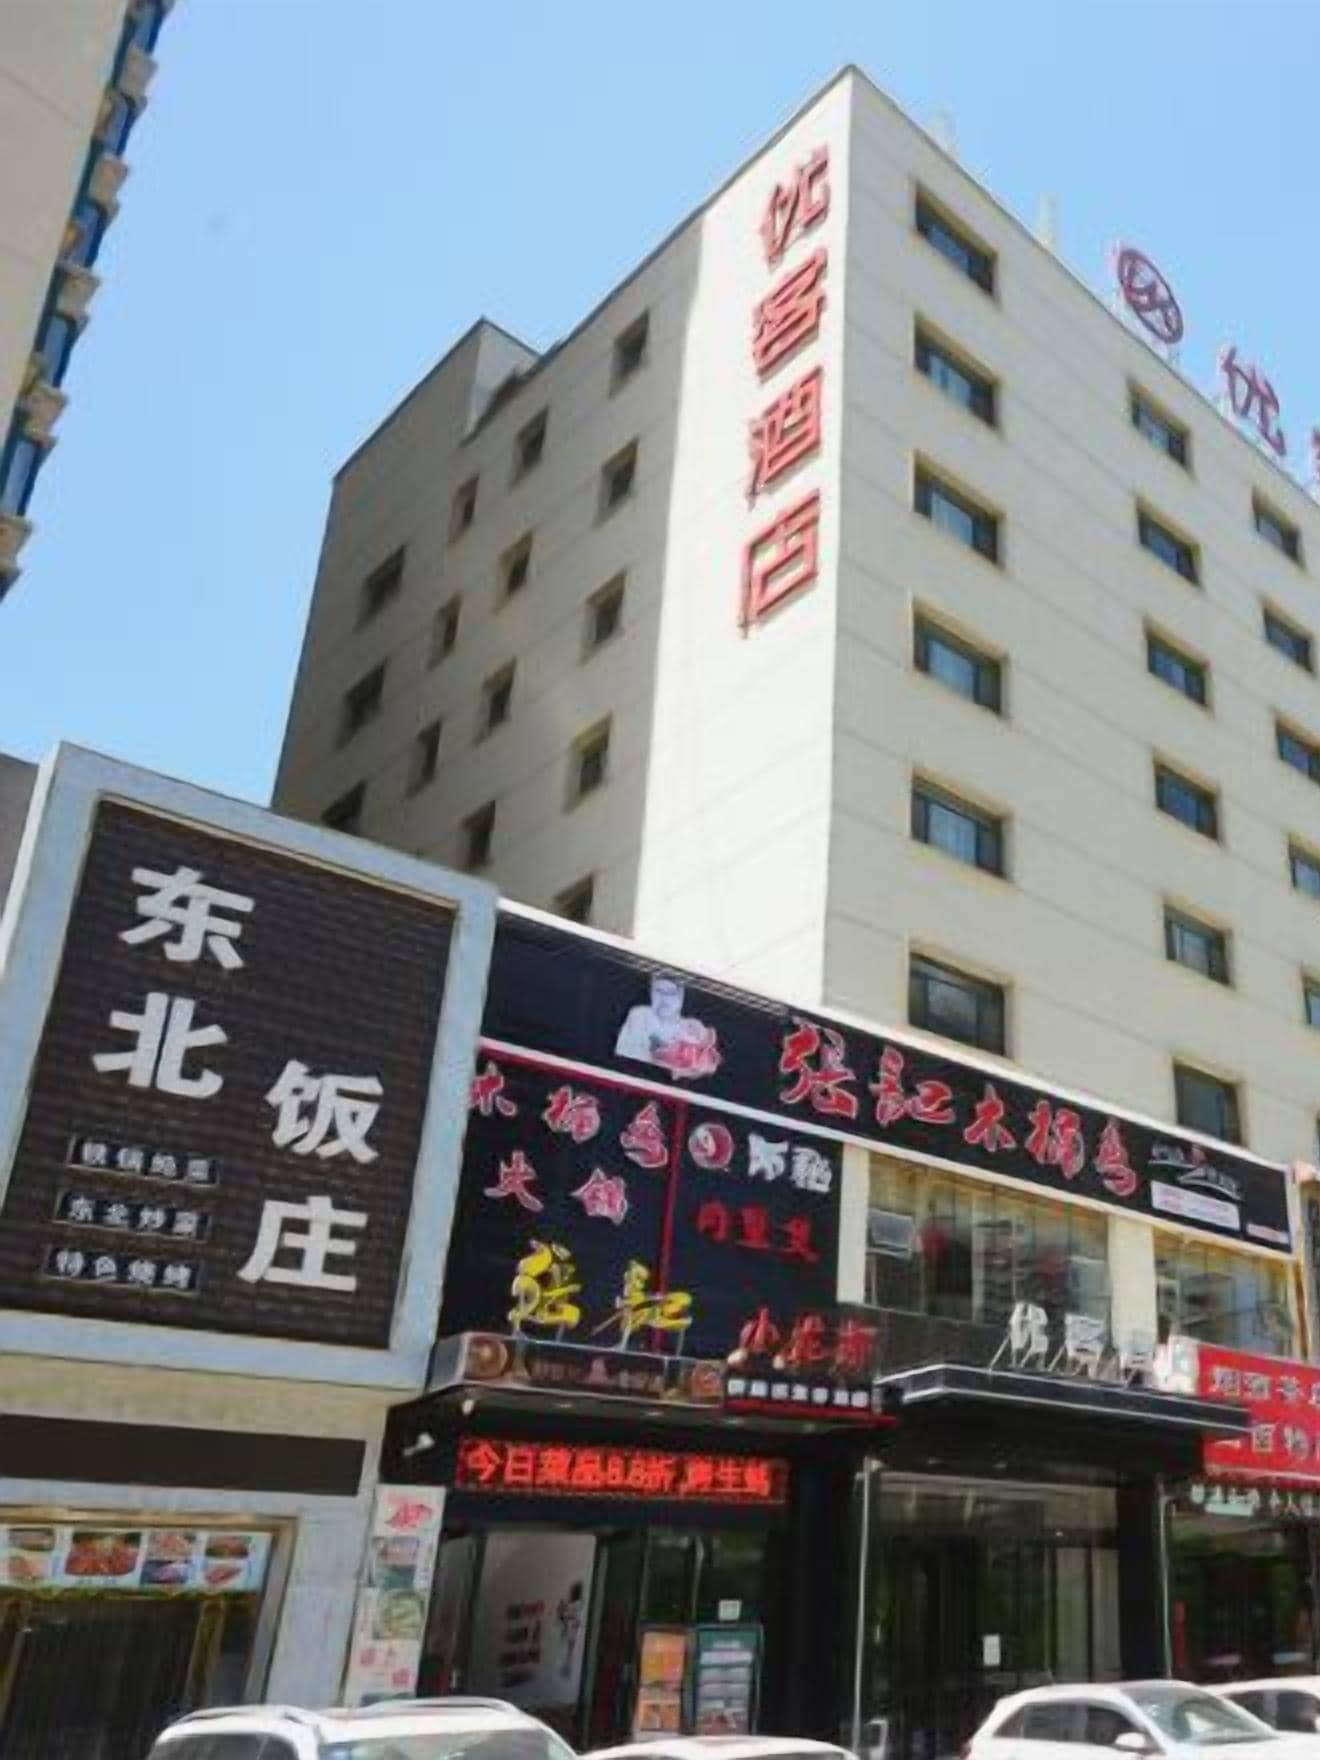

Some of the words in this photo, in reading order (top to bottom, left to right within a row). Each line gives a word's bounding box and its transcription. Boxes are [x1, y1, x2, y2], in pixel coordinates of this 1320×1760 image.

[738, 145, 831, 640] 优客酒店
[92, 866, 254, 1100] 东北
[237, 1058, 384, 1292] 饭庄
